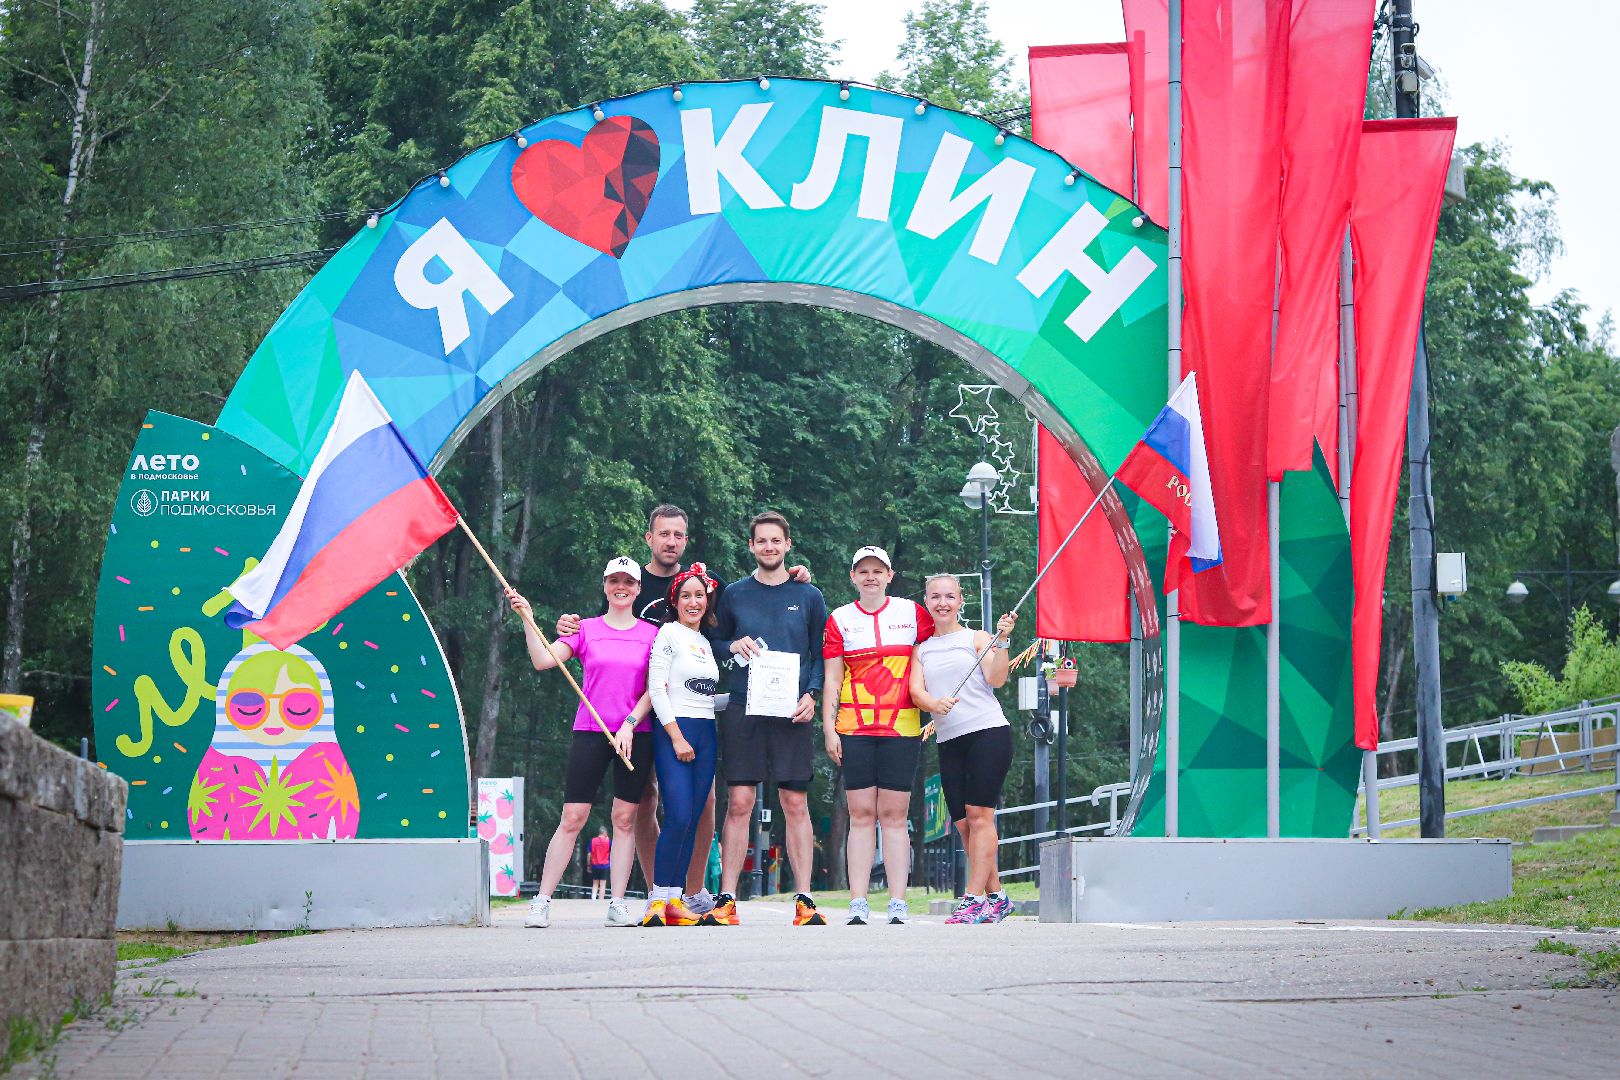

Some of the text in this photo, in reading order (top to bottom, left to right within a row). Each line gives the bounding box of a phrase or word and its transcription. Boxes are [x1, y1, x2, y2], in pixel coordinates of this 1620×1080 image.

[395, 102, 1157, 354] Я КЛИН
[138, 473, 199, 481] подмосковье
[161, 490, 210, 502] ПАРКИ
[160, 504, 276, 516] ПОДМОСКОВЬЯ
